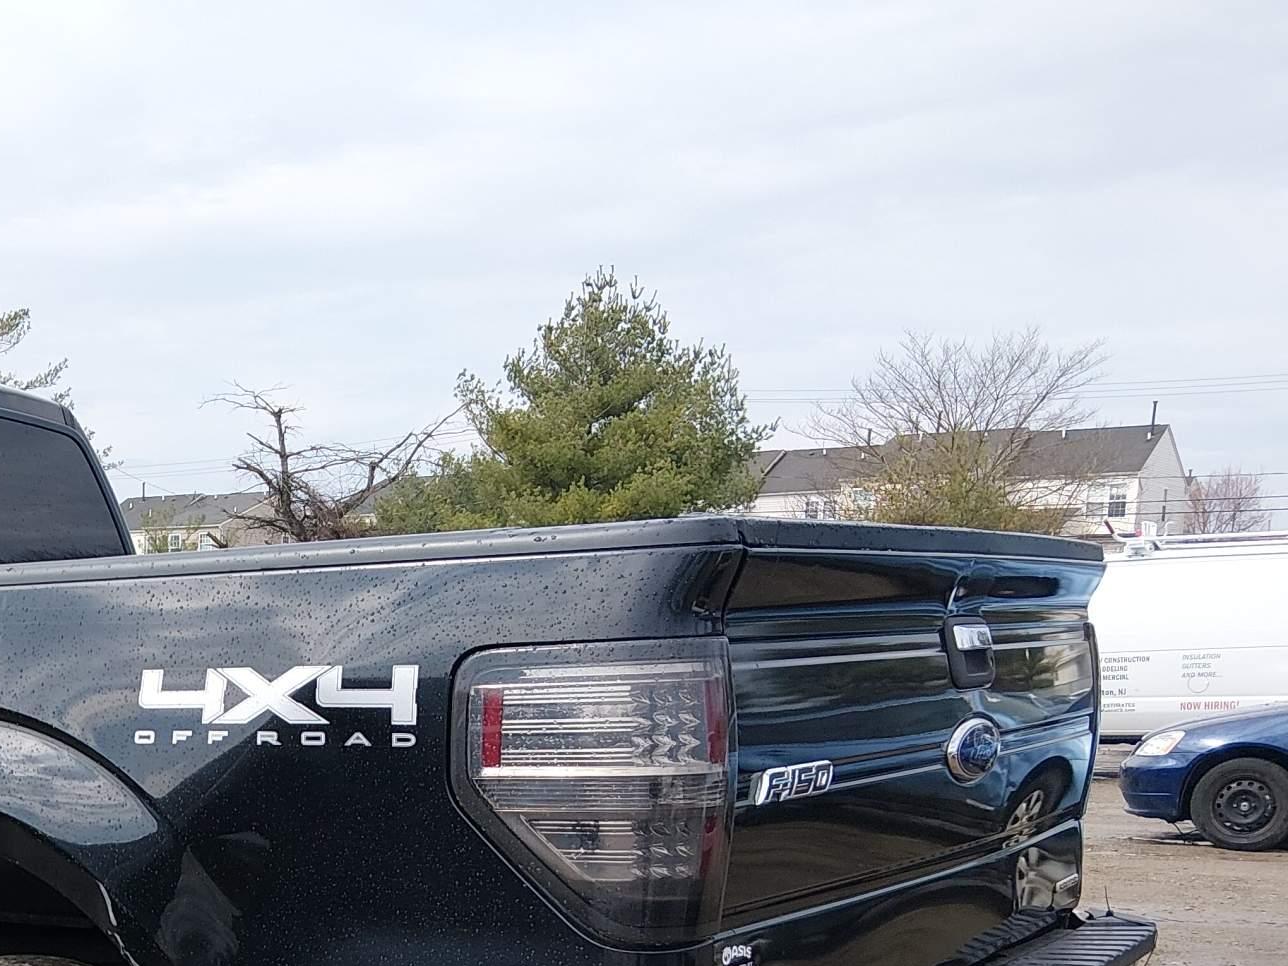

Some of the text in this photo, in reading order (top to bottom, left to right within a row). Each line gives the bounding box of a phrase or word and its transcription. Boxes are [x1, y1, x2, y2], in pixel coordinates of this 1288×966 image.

[1104, 656, 1150, 664] CONSTRUCTION
[138, 665, 419, 725] 4X4
[1102, 689, 1117, 697] ton,
[1180, 701, 1201, 711] NOW
[134, 730, 417, 747] OFF ROAD
